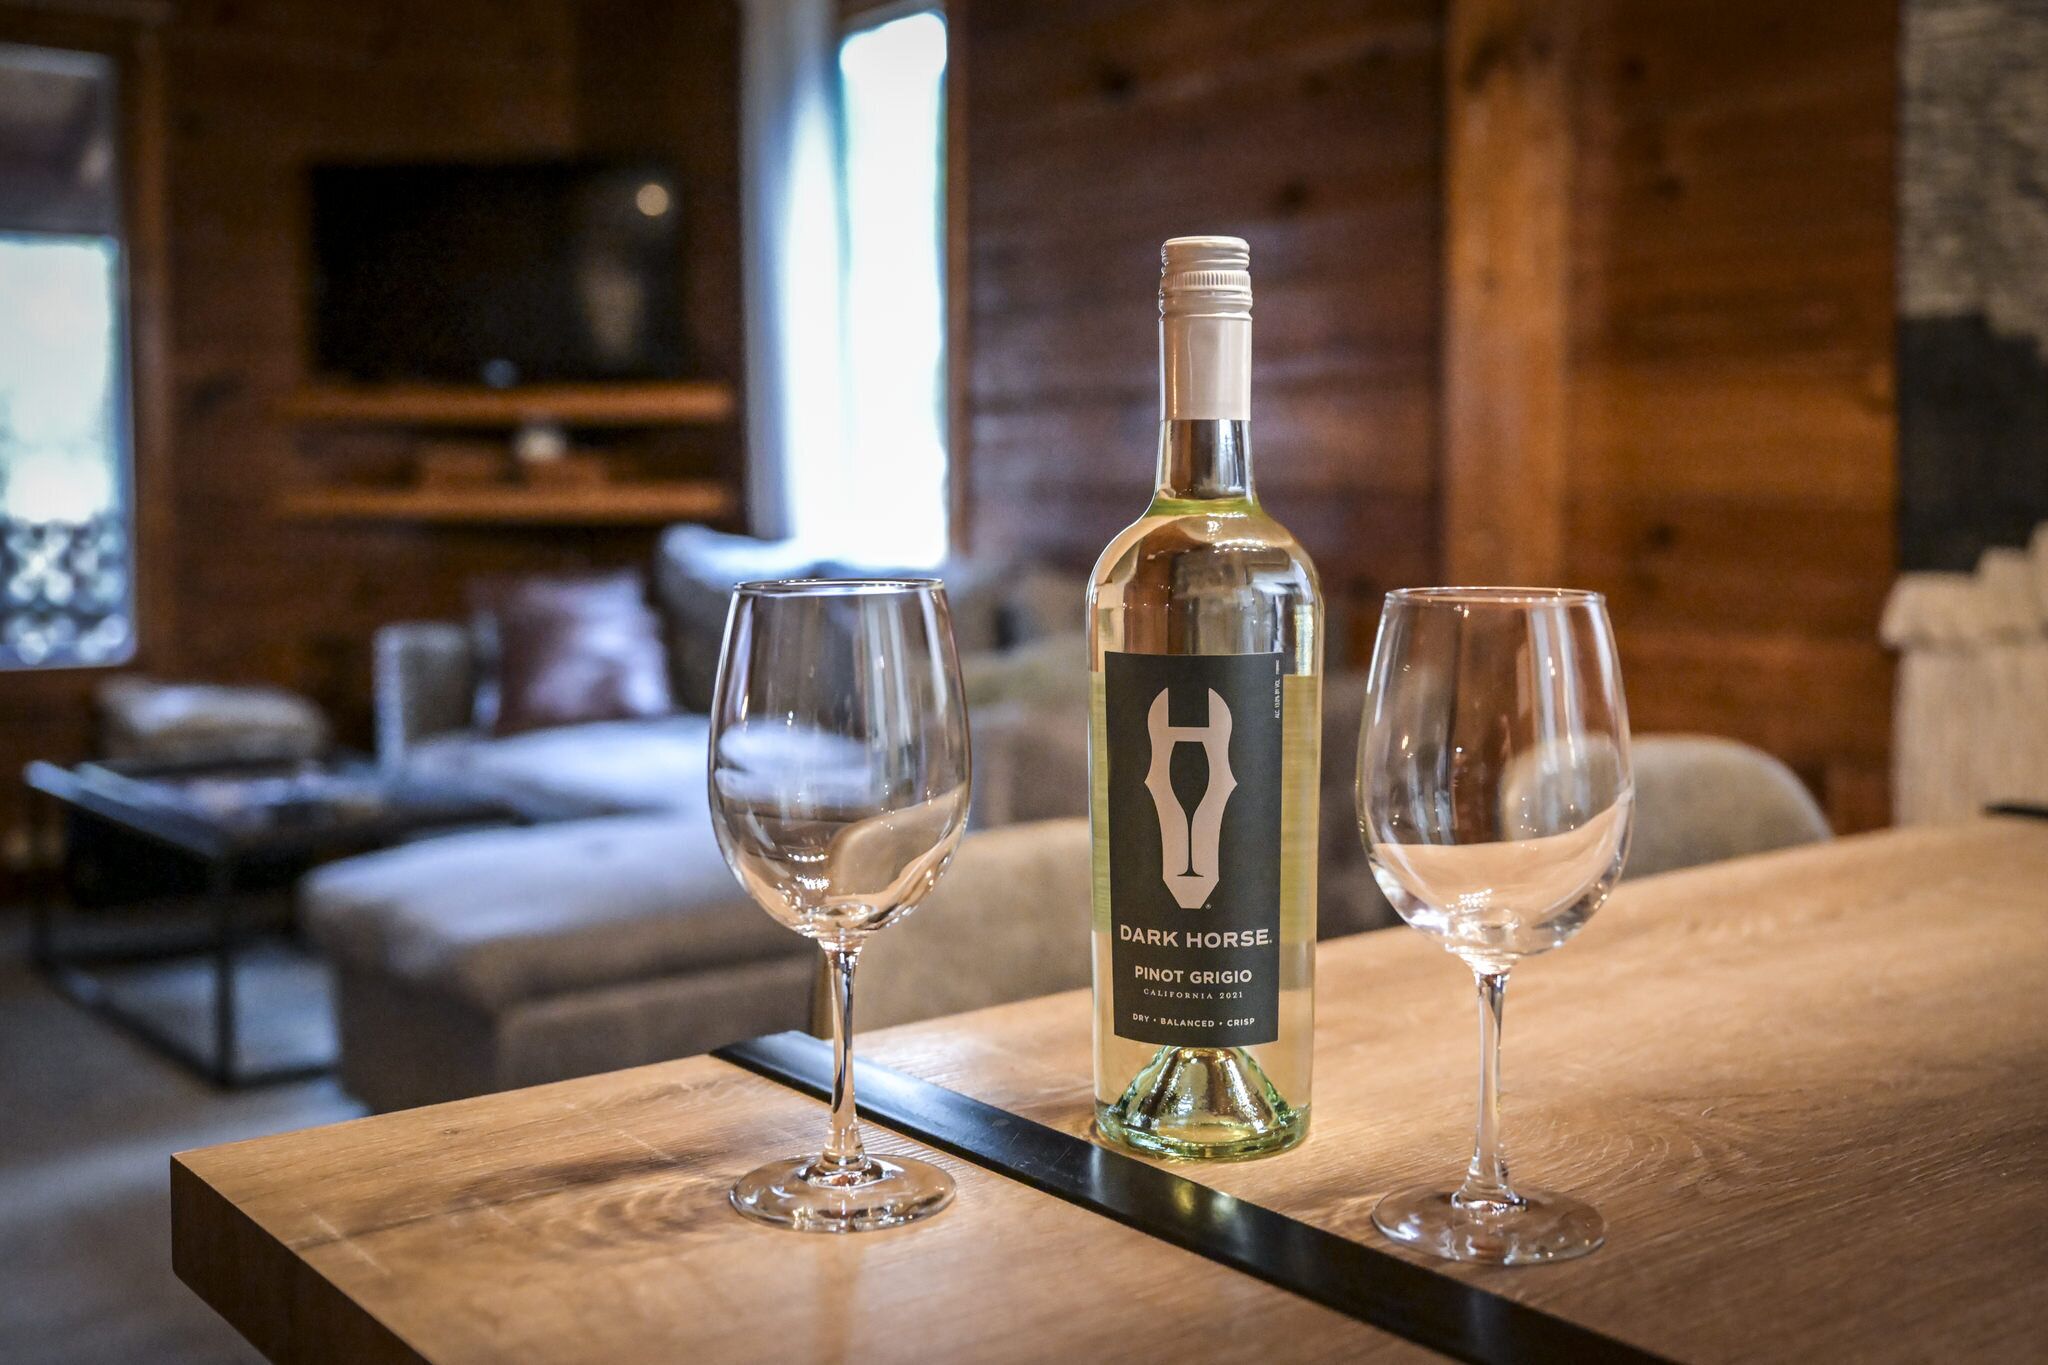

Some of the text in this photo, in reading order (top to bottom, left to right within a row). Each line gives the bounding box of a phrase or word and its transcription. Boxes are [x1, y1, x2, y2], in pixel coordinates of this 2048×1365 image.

[1120, 924, 1179, 948] DARK
[1134, 965, 1253, 985] PINOT GRIGIO
[1143, 988, 1243, 1000] CALIFORNIA 2021
[1132, 1013, 1255, 1028] DRY BALANCED CRISP
